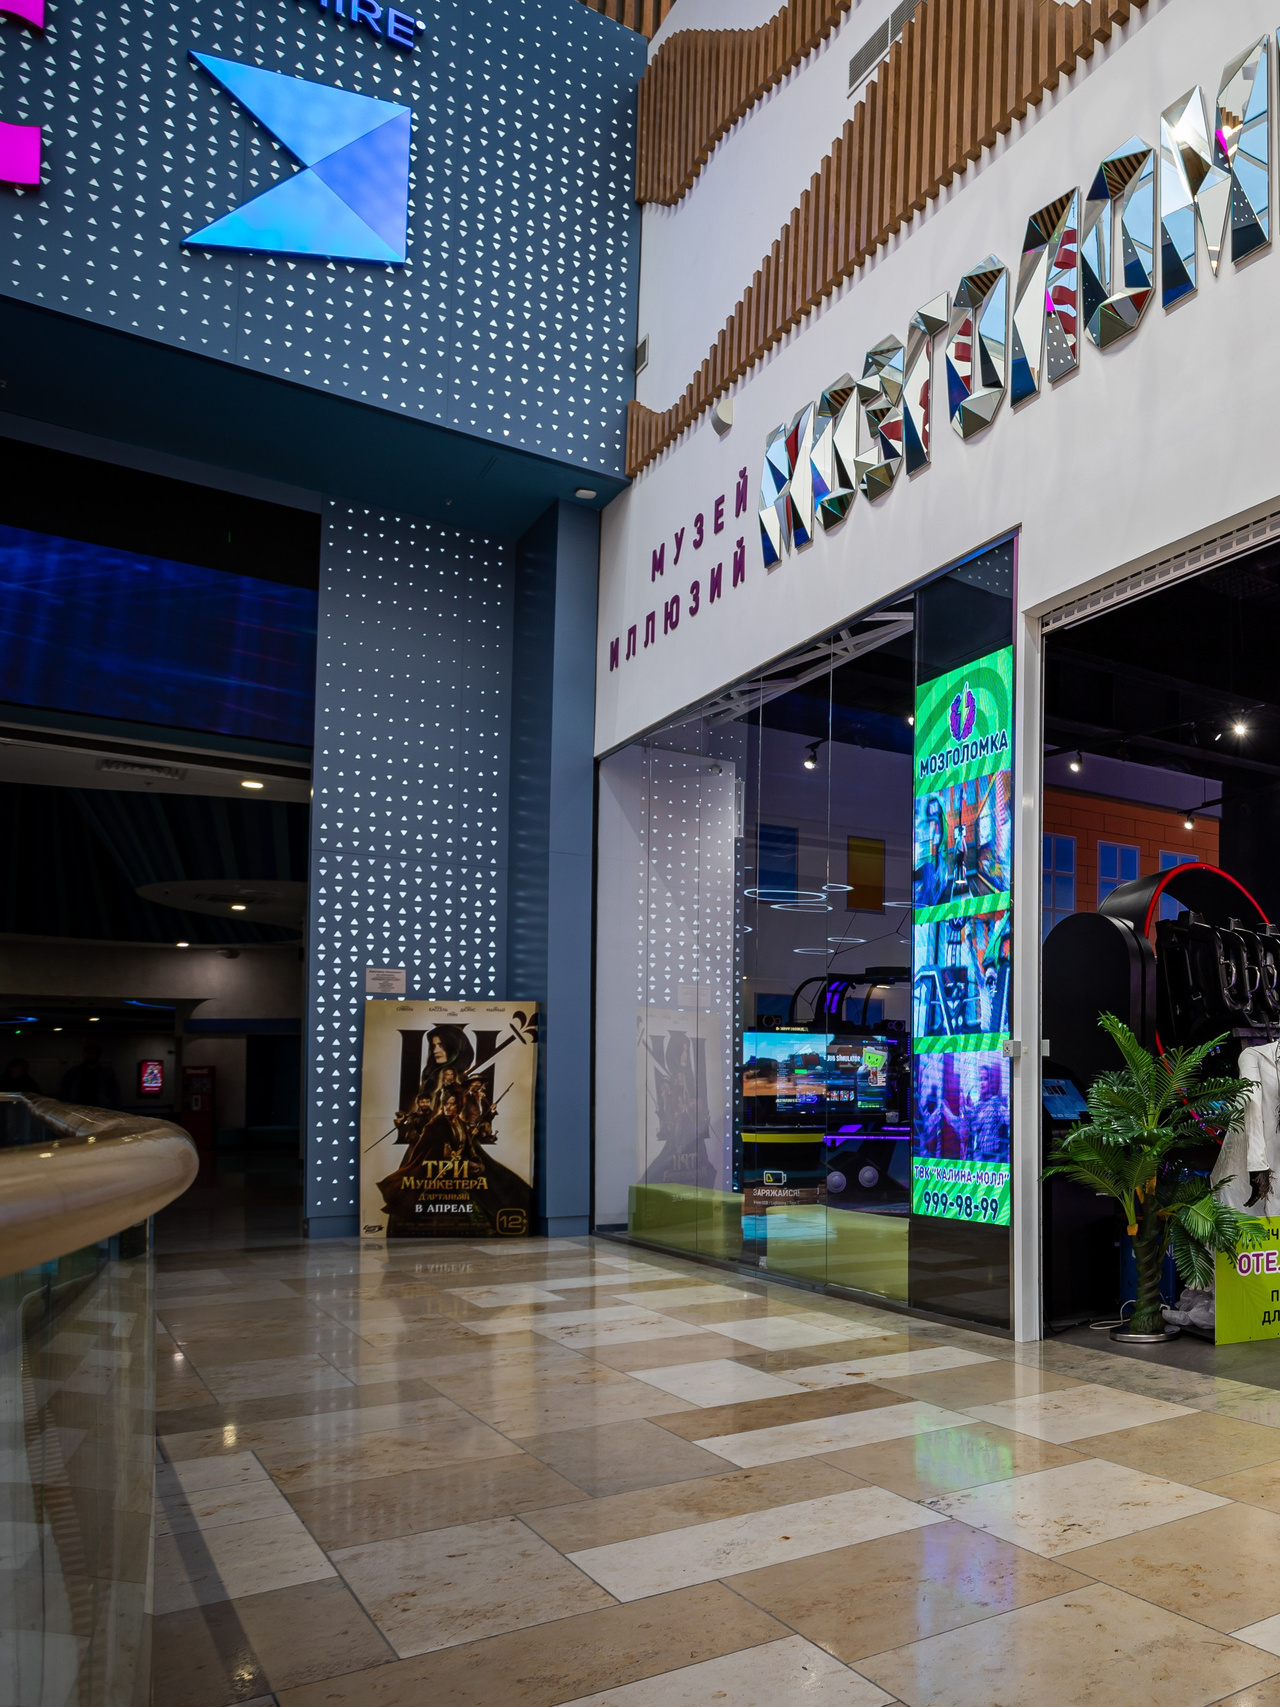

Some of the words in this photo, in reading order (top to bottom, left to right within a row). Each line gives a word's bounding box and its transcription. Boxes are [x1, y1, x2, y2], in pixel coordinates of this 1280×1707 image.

[651, 466, 749, 583] МУЗЕЙ
[609, 536, 746, 672] ИЛЛЮЗИЙ
[920, 729, 1009, 779] МОЗГОЛОМКА
[422, 1159, 470, 1179] ТРИ
[914, 1165, 930, 1180] ТВК
[931, 1166, 1010, 1187] "КАЛИНА-МОЛЛ"
[401, 1176, 489, 1190] МУШКЕТЕРА
[753, 1187, 800, 1197] ЗАРЯЖАЙСЯ!
[415, 1204, 423, 1213] В
[427, 1204, 474, 1213] АПРЕЛЕ
[923, 1190, 999, 1221] 999-98-99
[499, 1215, 528, 1229] 12+
